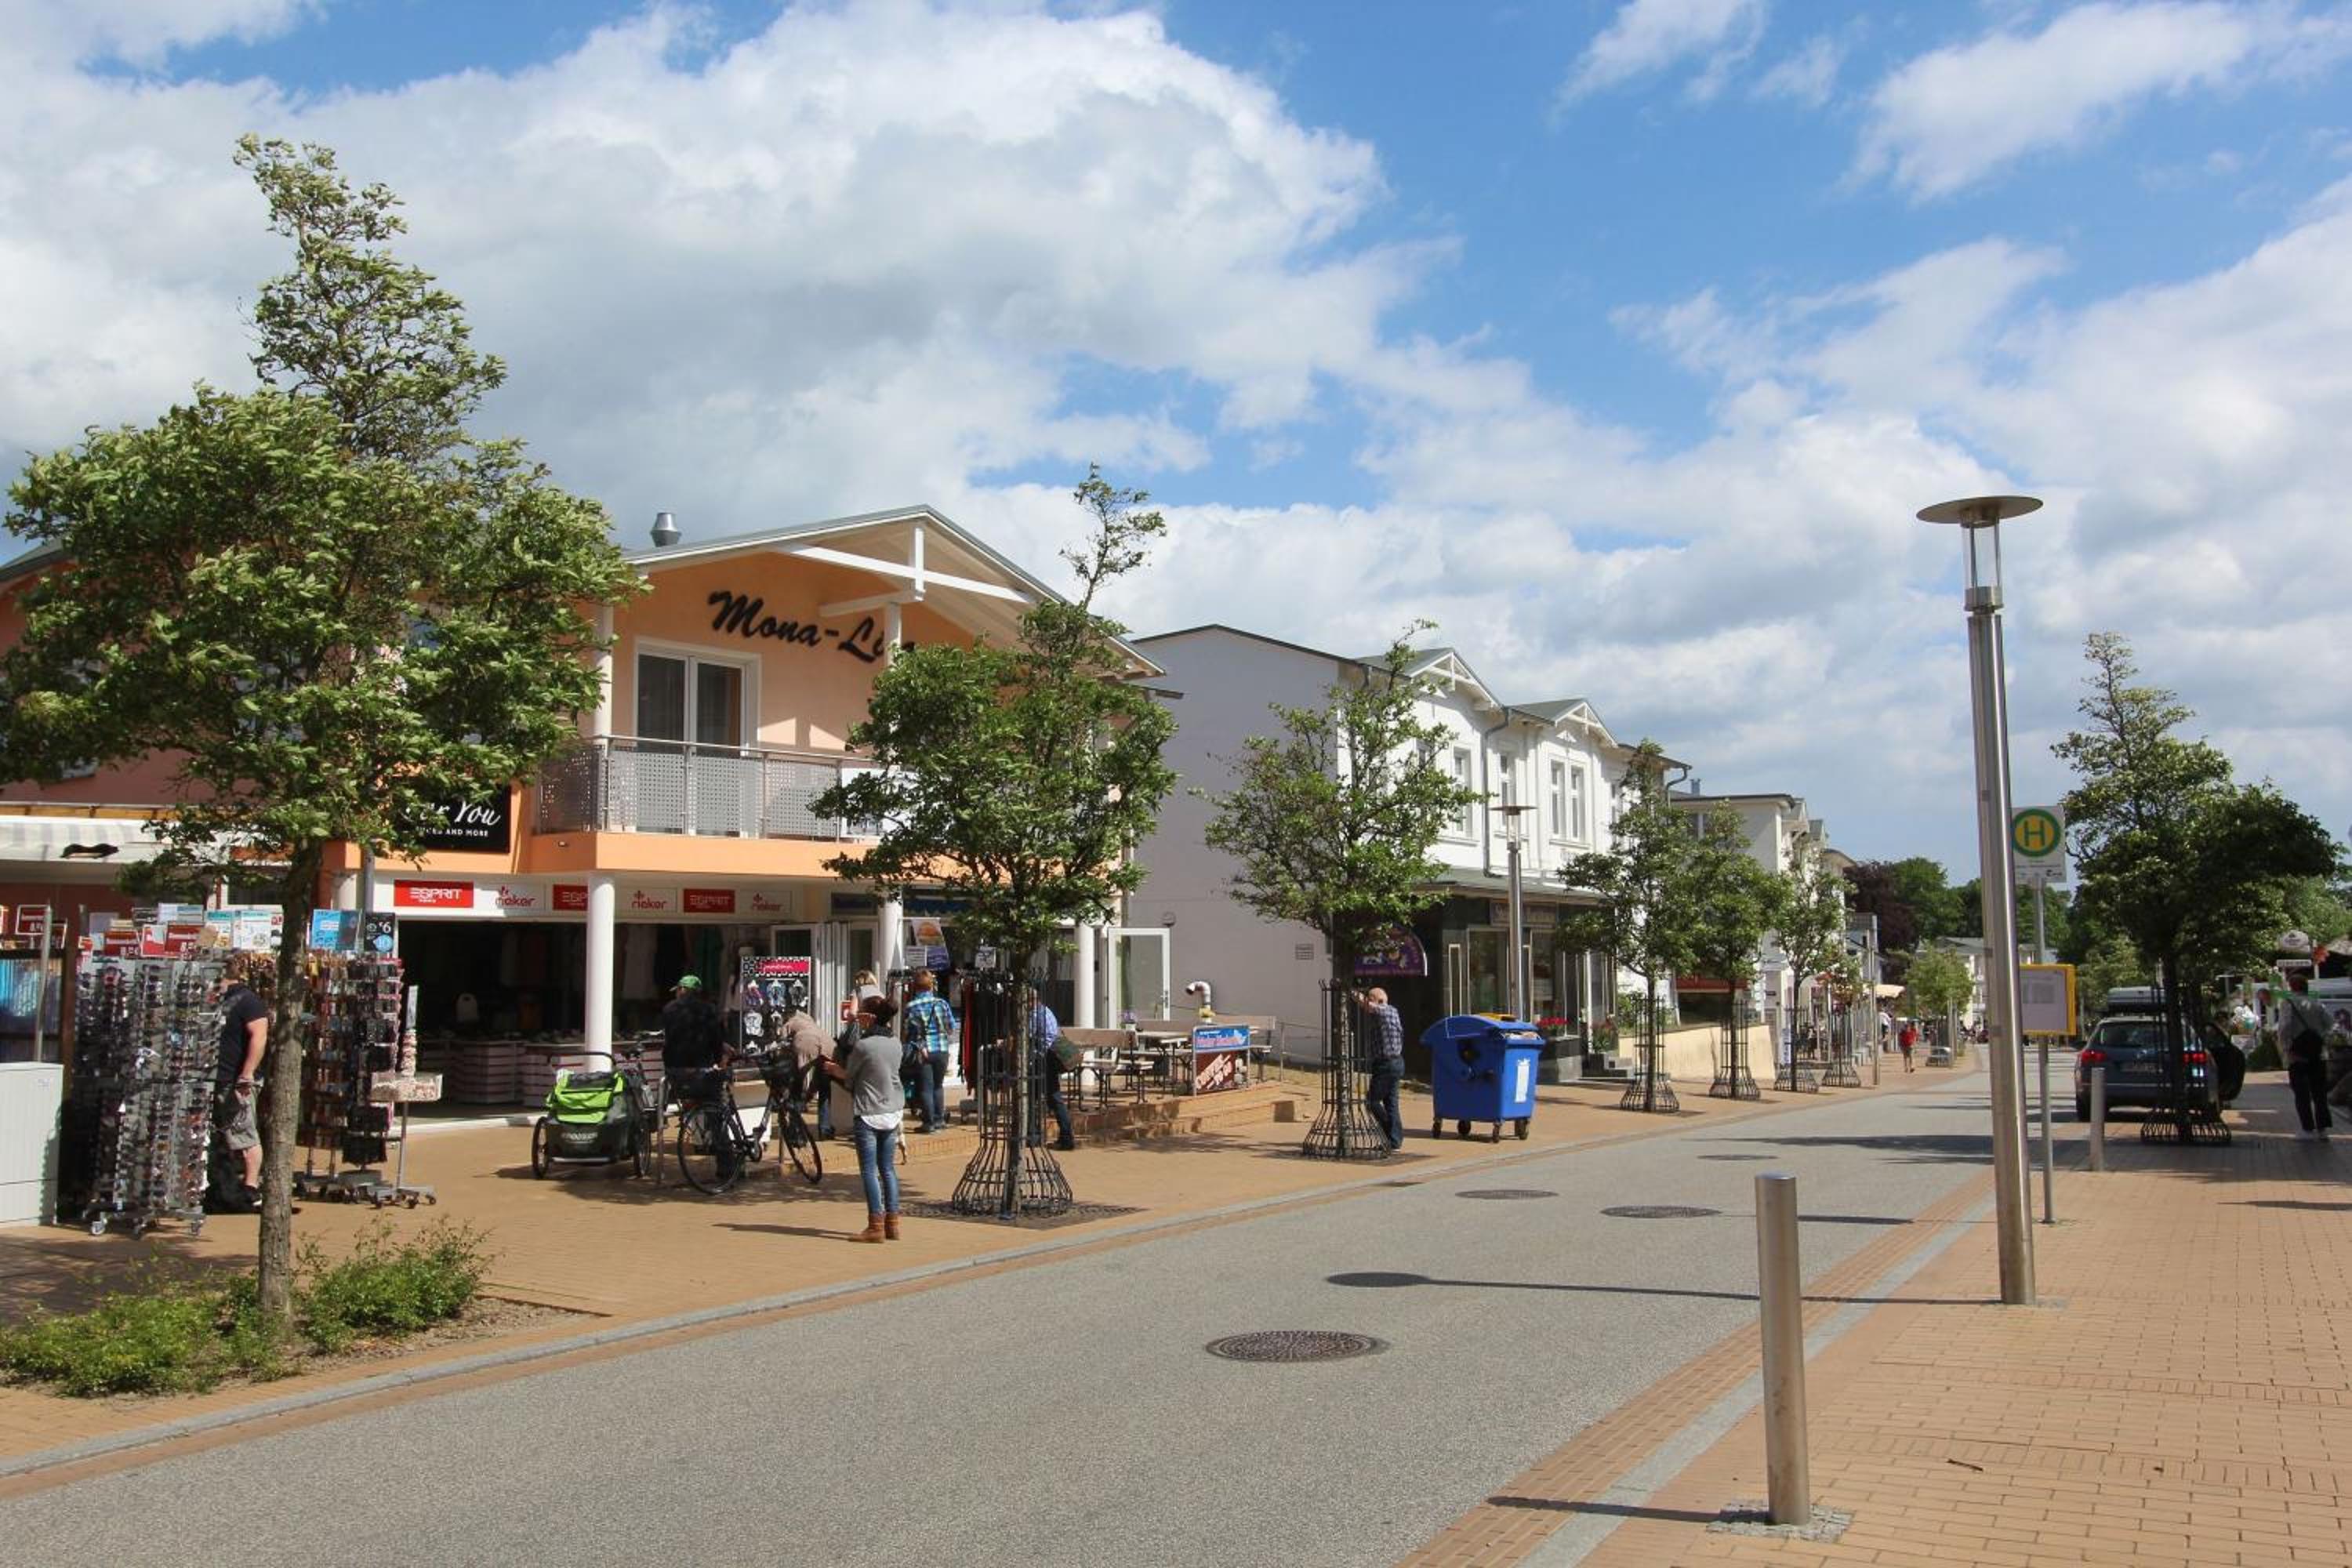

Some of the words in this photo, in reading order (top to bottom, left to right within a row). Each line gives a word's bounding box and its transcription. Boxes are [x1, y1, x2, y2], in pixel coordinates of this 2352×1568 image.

[452, 793, 501, 826] You
[2024, 819, 2045, 847] H
[409, 887, 463, 900] ESPRIT
[689, 895, 731, 906] ESPRIT
[631, 896, 666, 910] rieker
